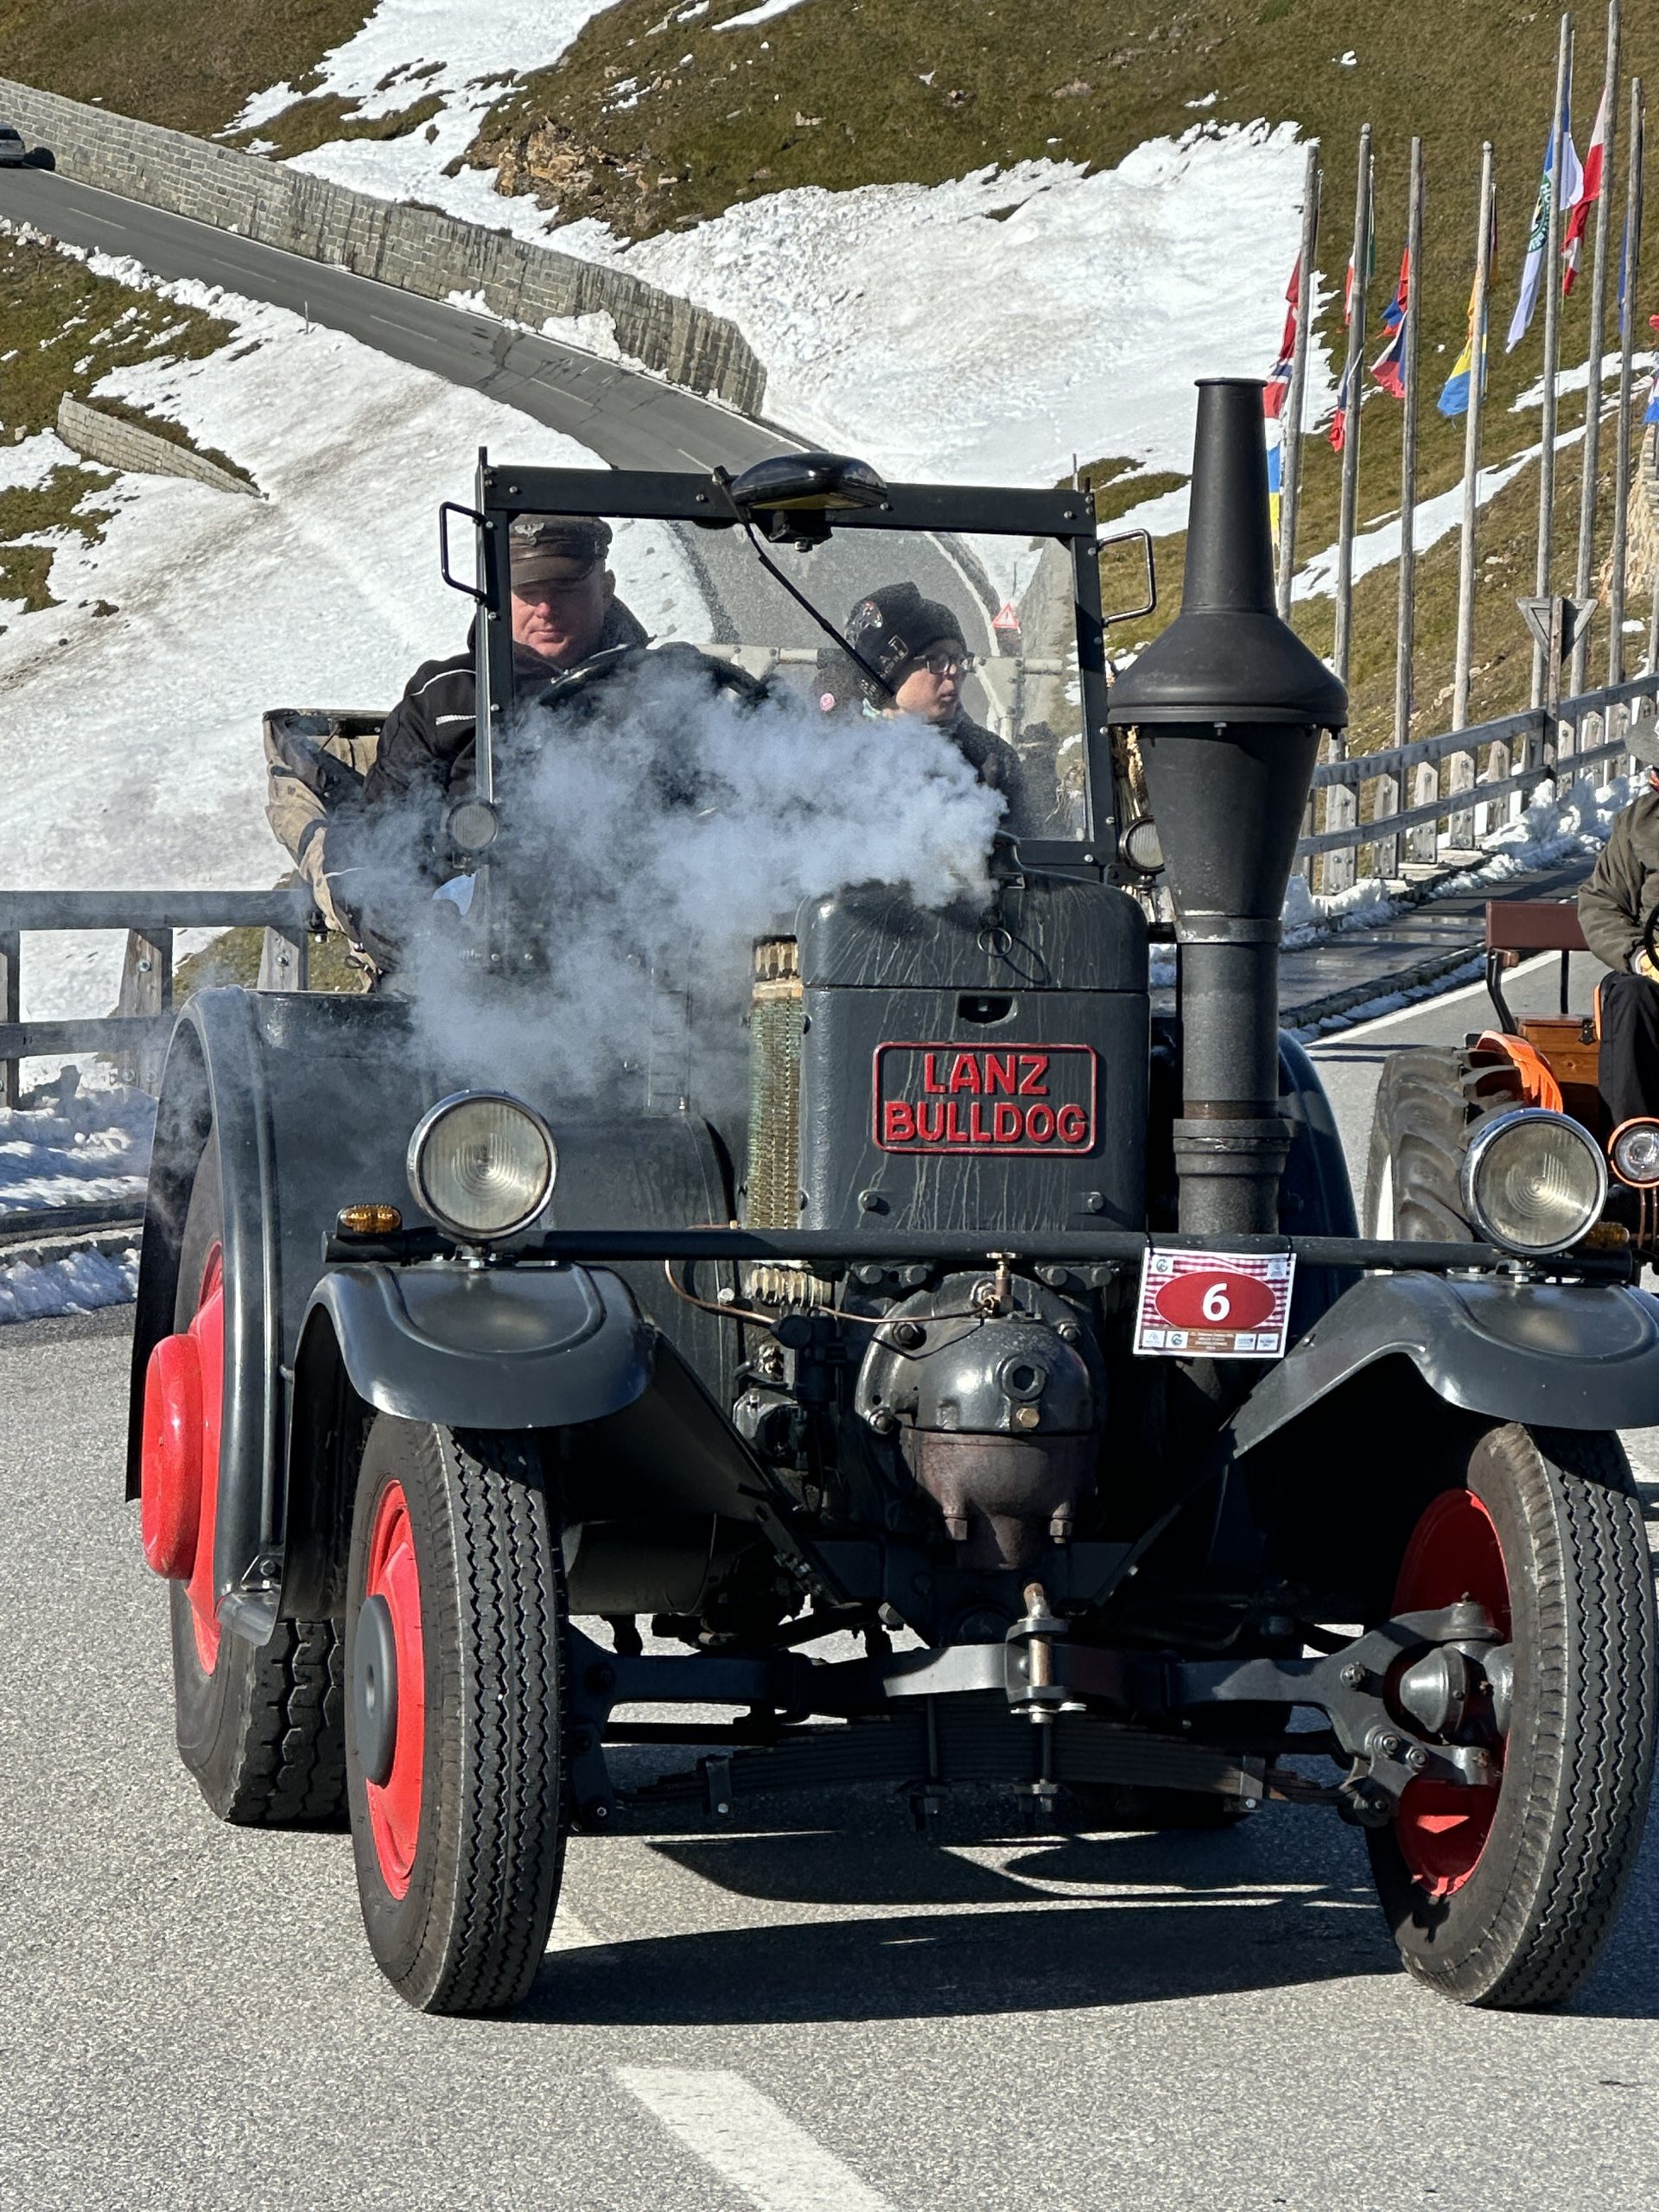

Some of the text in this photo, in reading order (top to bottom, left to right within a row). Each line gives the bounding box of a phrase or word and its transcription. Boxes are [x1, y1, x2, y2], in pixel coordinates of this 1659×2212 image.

[924, 1052, 1049, 1096] LANZ
[884, 1100, 1088, 1144] BULLDOG
[1202, 1282, 1230, 1322] 6
